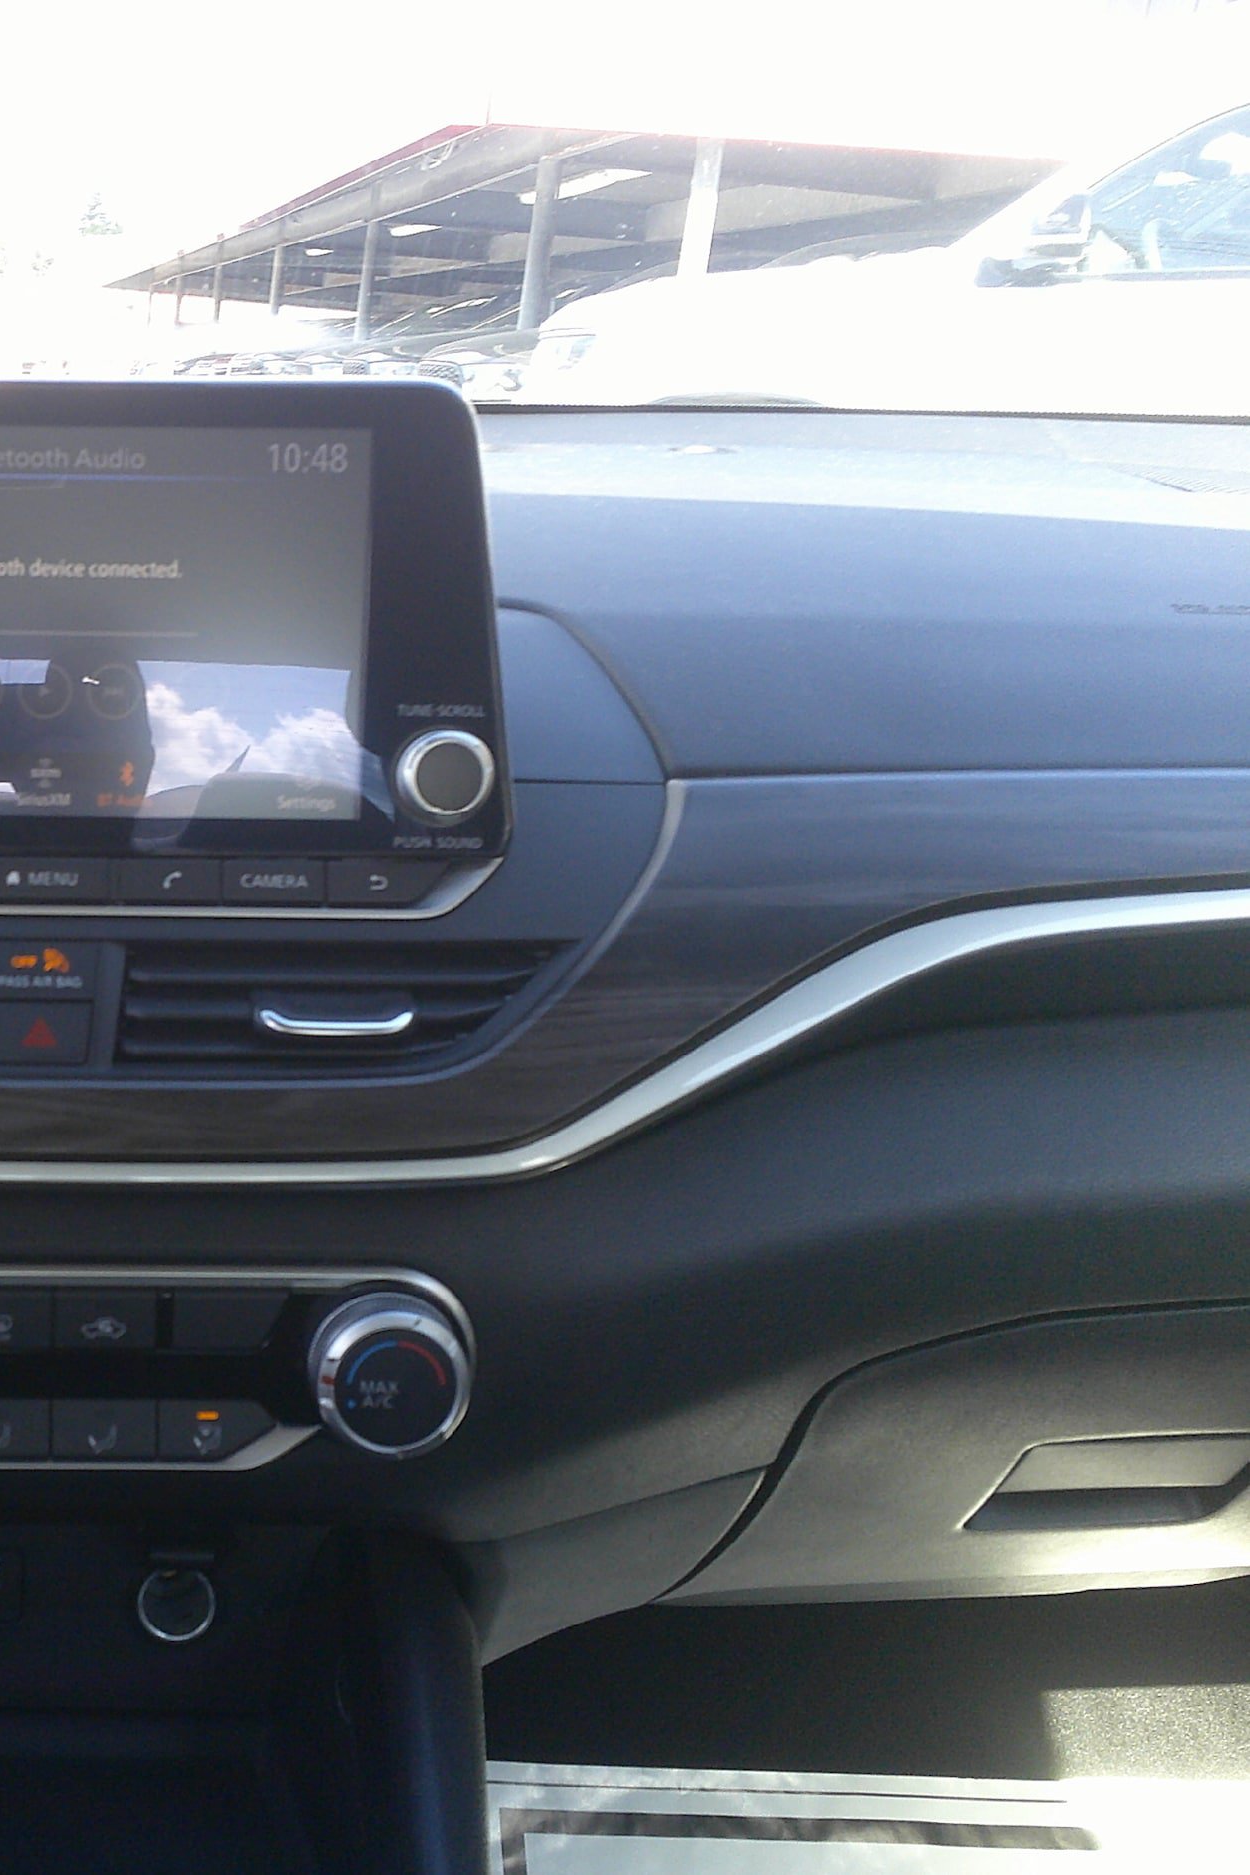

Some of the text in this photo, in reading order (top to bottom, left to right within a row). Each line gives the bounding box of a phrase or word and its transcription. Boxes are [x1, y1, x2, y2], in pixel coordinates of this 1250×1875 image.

[75, 447, 147, 470] Audio
[267, 442, 349, 474] 10:48
[29, 558, 86, 578] device
[277, 793, 337, 812] Settings
[436, 836, 483, 850] SOUND
[28, 872, 79, 888] MENU
[240, 873, 309, 890] CAMERA
[360, 1380, 398, 1394] MAX
